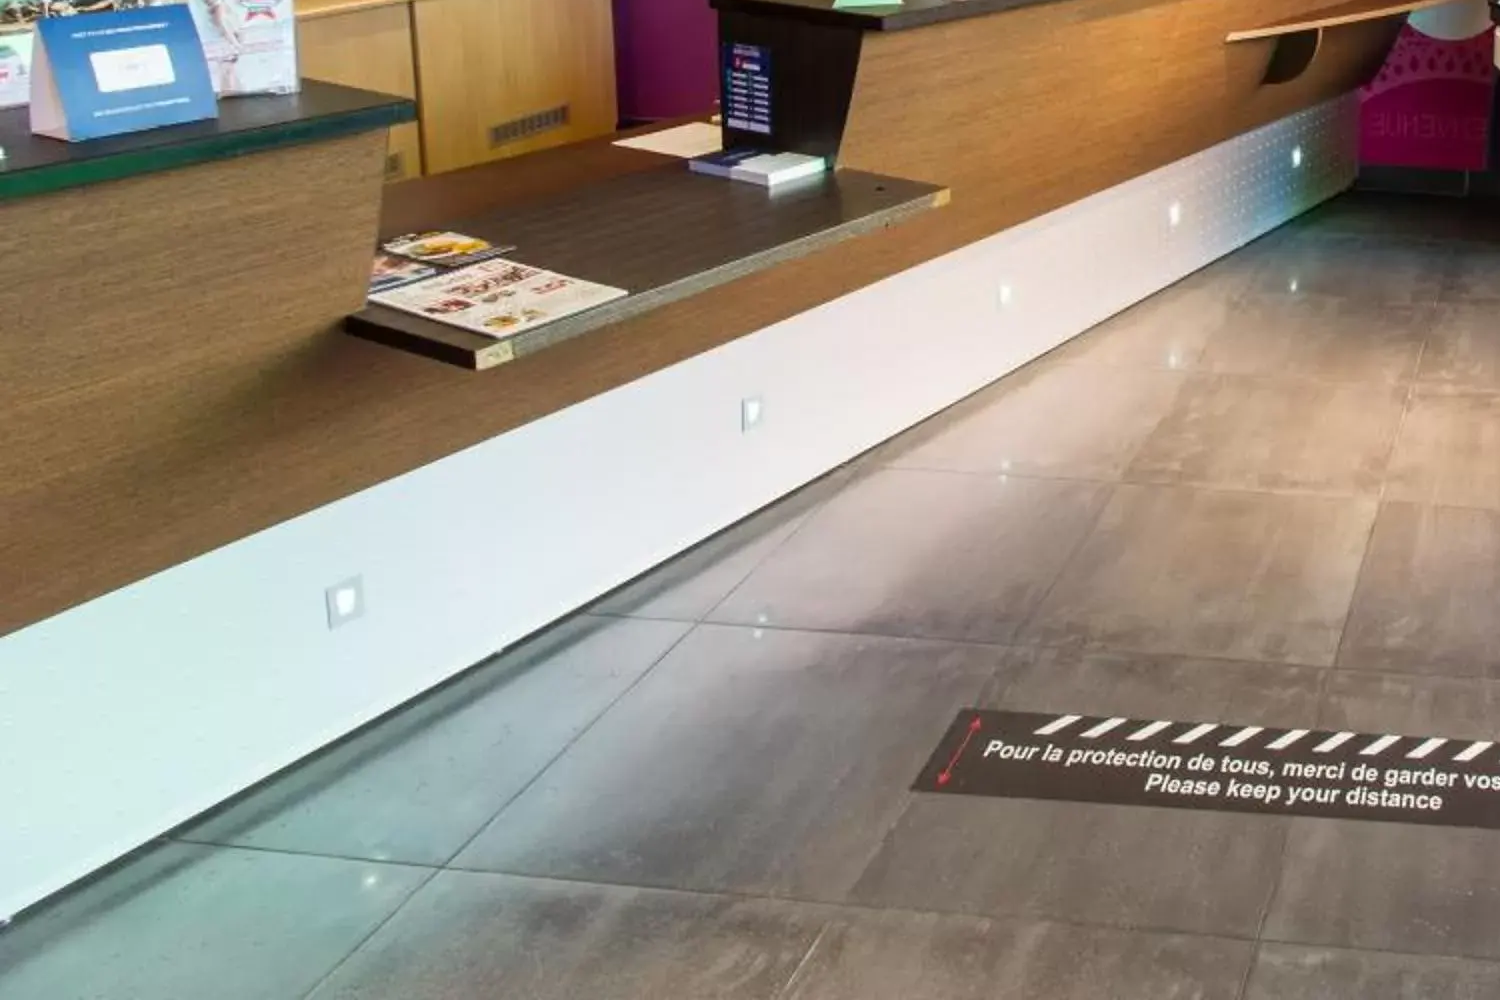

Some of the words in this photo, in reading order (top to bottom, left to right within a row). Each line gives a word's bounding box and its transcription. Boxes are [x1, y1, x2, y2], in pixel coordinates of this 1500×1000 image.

[983, 739, 1040, 760] Pour
[1041, 743, 1064, 762] la
[1064, 747, 1182, 770] protection
[1187, 752, 1216, 773] de
[1220, 754, 1275, 778] tous,
[1282, 761, 1347, 780] merci
[1351, 763, 1379, 782] de
[1384, 767, 1459, 787] garder
[1144, 772, 1221, 797] Please
[1226, 778, 1281, 804] keep
[1285, 787, 1341, 805] your
[1345, 785, 1443, 810] distance
